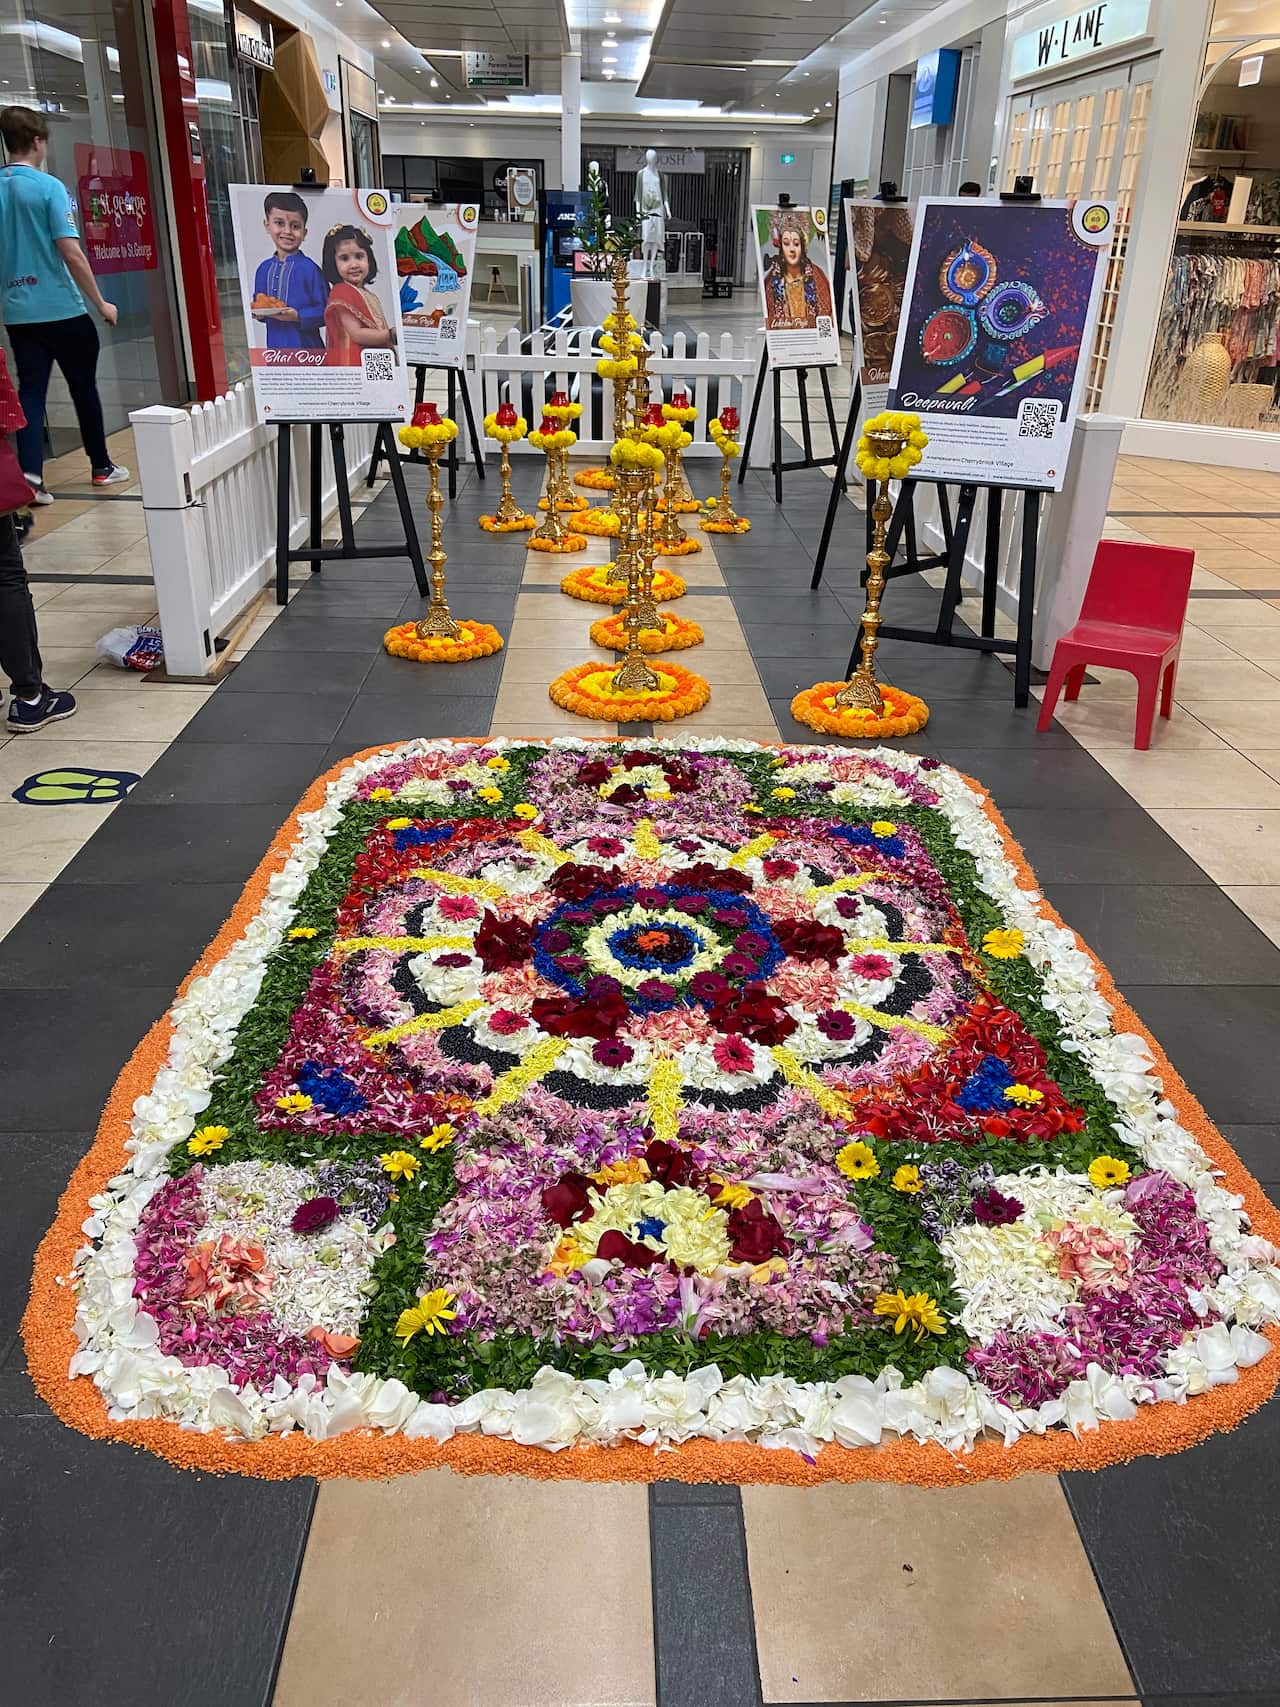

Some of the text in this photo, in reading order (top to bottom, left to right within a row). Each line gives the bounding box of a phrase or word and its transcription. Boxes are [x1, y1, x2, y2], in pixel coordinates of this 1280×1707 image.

[557, 212, 577, 221] ANZ
[94, 243, 121, 260] Welcome
[262, 349, 328, 366] Bhai Dooj
[900, 391, 978, 411] Deepavali
[960, 457, 994, 466] Cherrybrook
[995, 459, 1014, 468] Village
